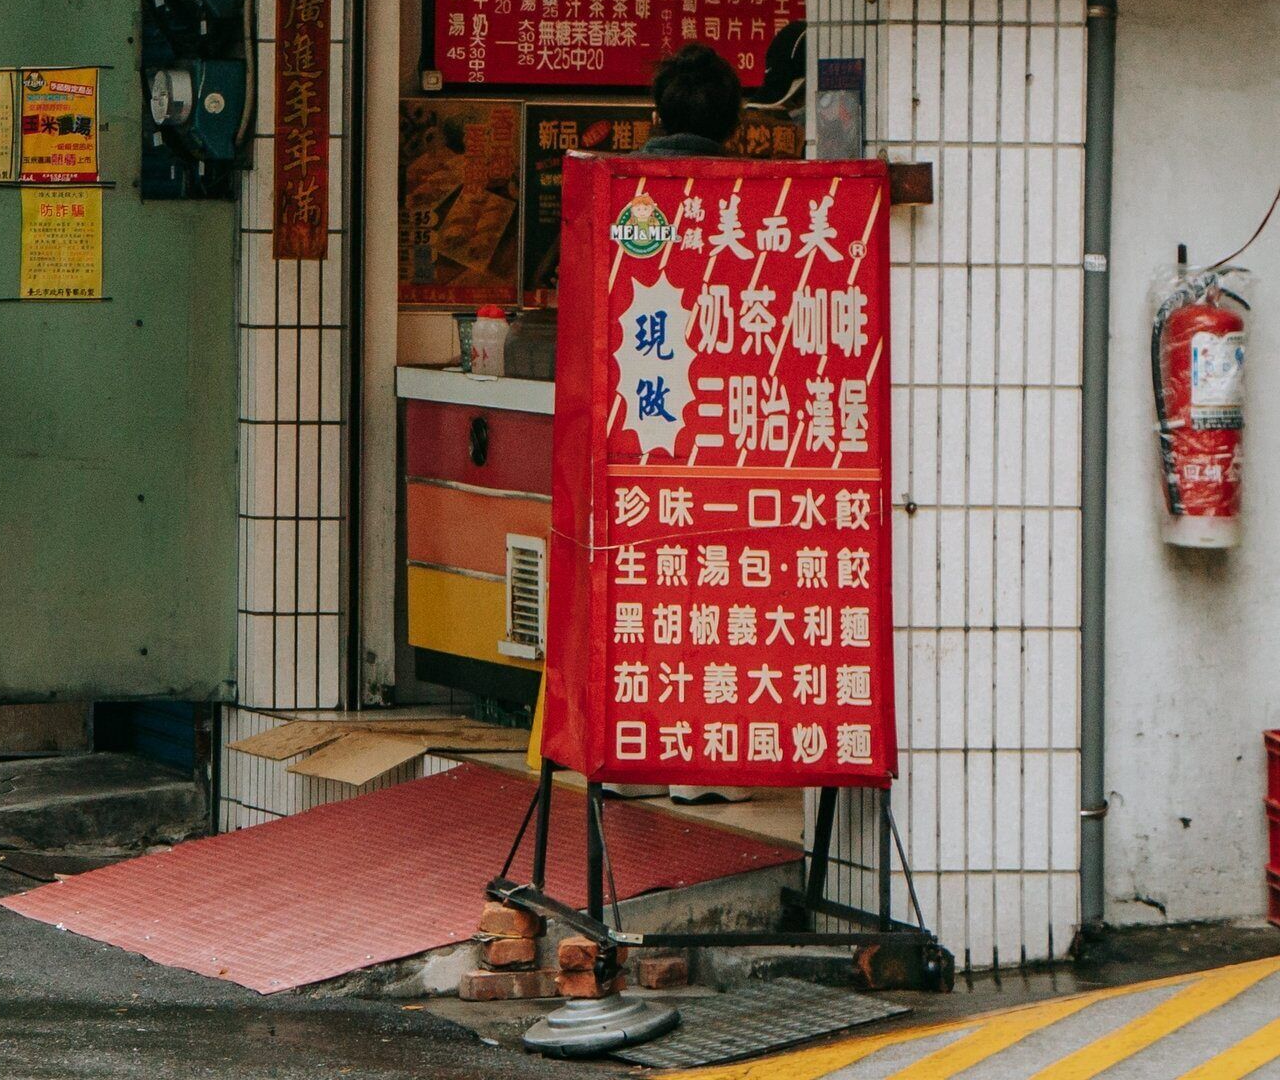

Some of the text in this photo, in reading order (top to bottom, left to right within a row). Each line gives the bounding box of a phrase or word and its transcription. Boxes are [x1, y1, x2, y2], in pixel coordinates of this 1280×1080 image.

[538, 20, 638, 47] 無糖茉香綠茶
[446, 46, 466, 59] 45
[537, 46, 604, 71] 大25中20
[738, 52, 754, 69] 30
[539, 120, 579, 150] 新品
[708, 194, 844, 263] 美而美
[614, 485, 871, 531] 珍味一口水餃
[613, 602, 871, 648] 黑胡椒義大利麵
[614, 661, 873, 707] 茄汁義大利麵
[616, 720, 873, 765] 日式和風炒麵
